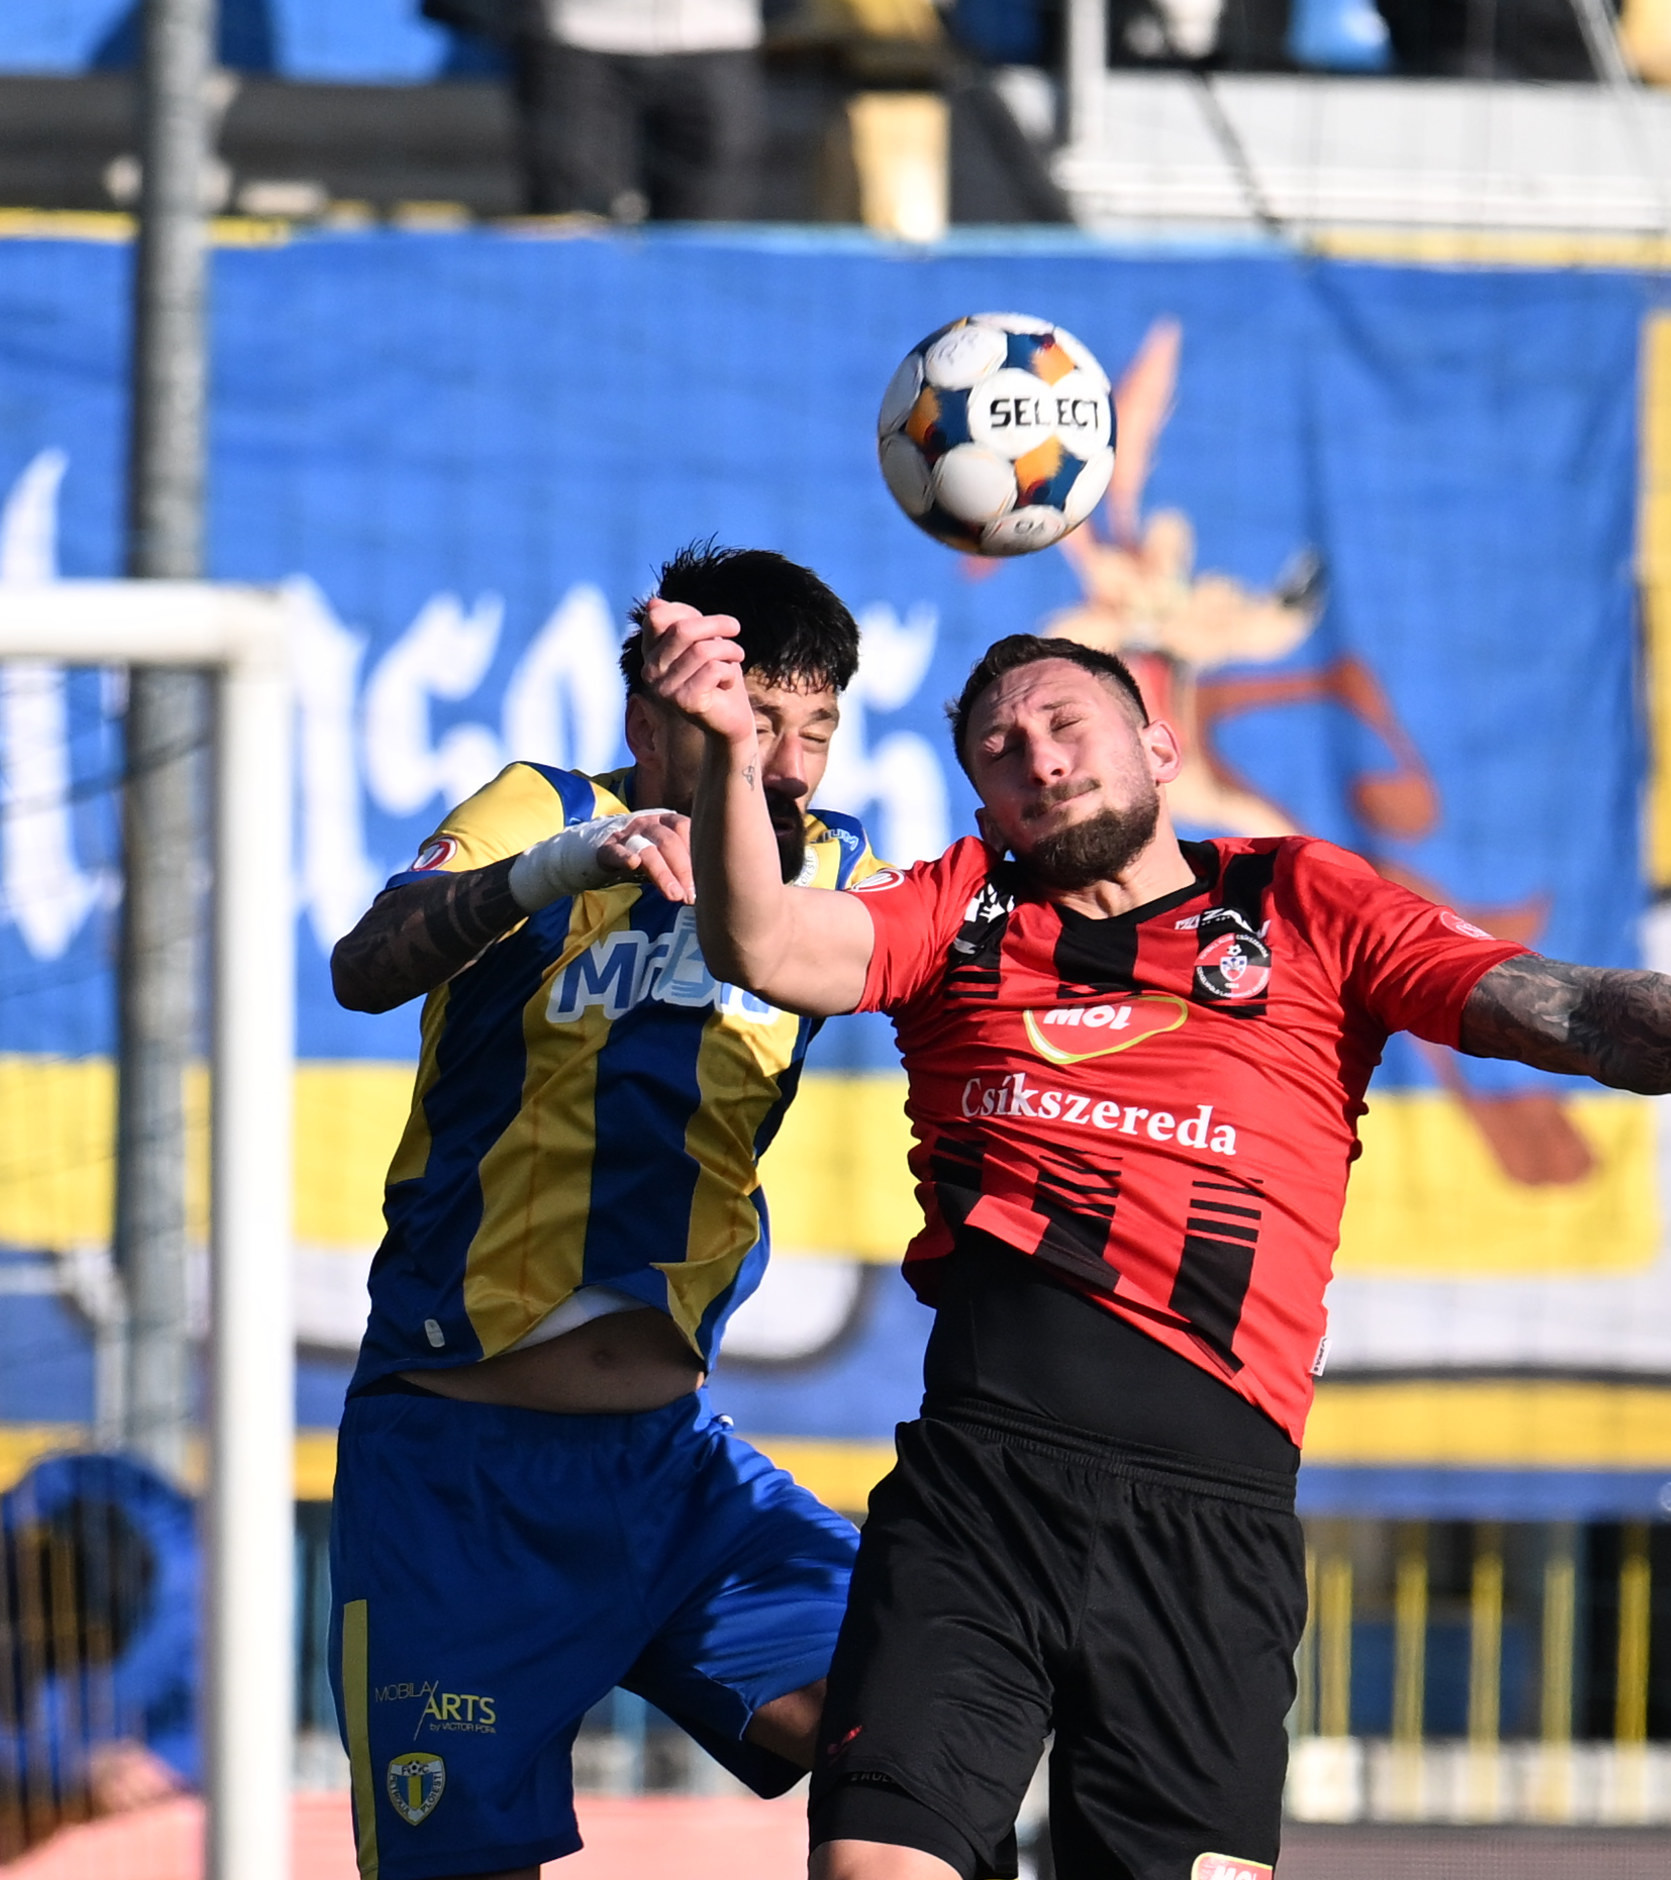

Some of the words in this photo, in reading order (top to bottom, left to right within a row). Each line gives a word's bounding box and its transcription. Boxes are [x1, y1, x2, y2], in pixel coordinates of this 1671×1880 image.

[989, 397, 1099, 430] SELECT
[960, 1071, 1237, 1157] Csíkszereda
[375, 1681, 432, 1703] MOBILA
[425, 1692, 497, 1725] ARTS
